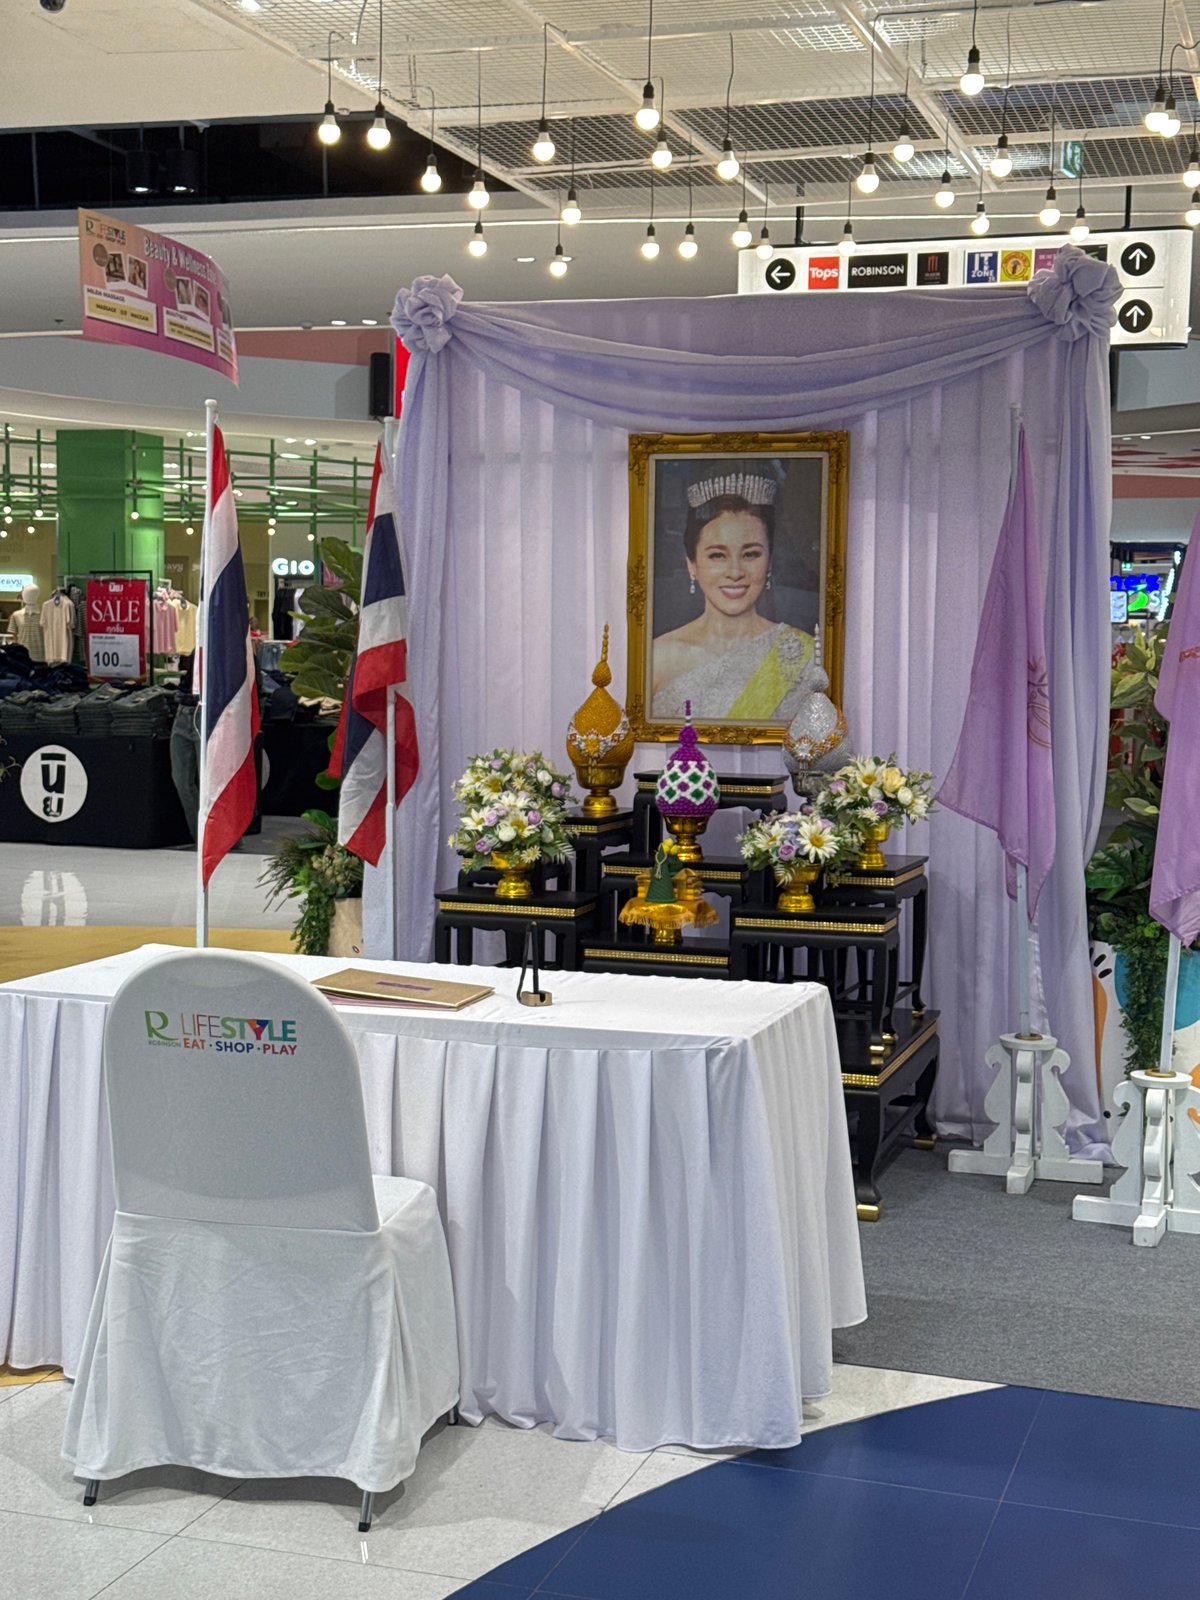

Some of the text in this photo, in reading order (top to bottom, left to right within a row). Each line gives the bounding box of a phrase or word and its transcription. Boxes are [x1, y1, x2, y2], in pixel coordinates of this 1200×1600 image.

[144, 236, 171, 268] Beauty
[172, 246, 178, 267] &
[851, 265, 905, 277] ROBINSON
[974, 253, 993, 271] IT
[810, 267, 838, 280] Tops
[971, 270, 995, 278] ZONE
[102, 292, 126, 303] MASSAGE
[272, 557, 315, 576] GIO
[0, 578, 23, 587] eavy
[1109, 572, 1160, 592] ne's
[91, 600, 140, 623] SALE
[94, 651, 119, 667] 100
[180, 1012, 297, 1042] LIFESTYLE
[183, 1037, 297, 1056] EAT SHOP PLAY
